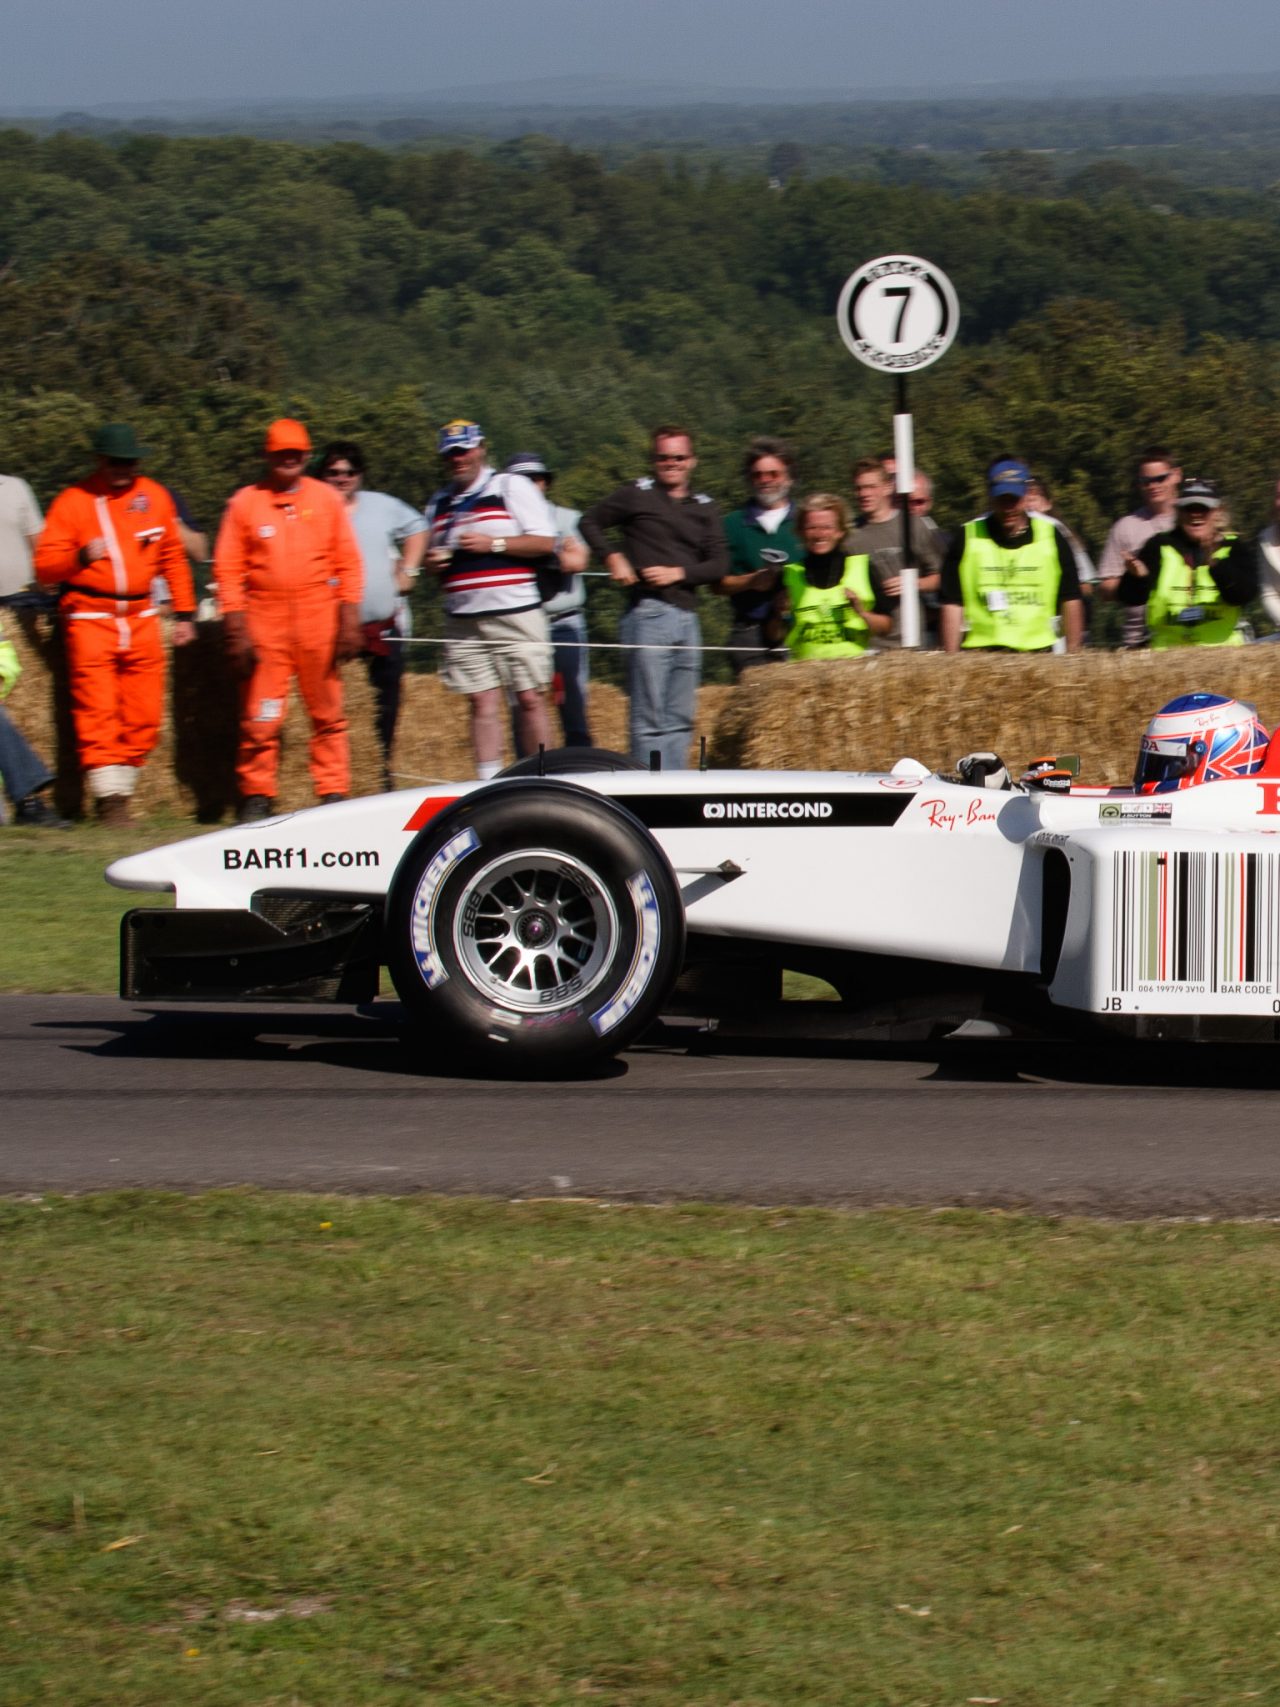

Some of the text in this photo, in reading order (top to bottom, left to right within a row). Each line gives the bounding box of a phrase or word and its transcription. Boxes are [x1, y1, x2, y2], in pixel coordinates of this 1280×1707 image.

[882, 286, 912, 343] 7
[726, 802, 833, 819] INTERCOND
[920, 798, 997, 832] Ray-Ban
[223, 847, 380, 870] BARf1.com
[1220, 985, 1272, 994] BAR CODE
[1101, 997, 1122, 1011] JB
